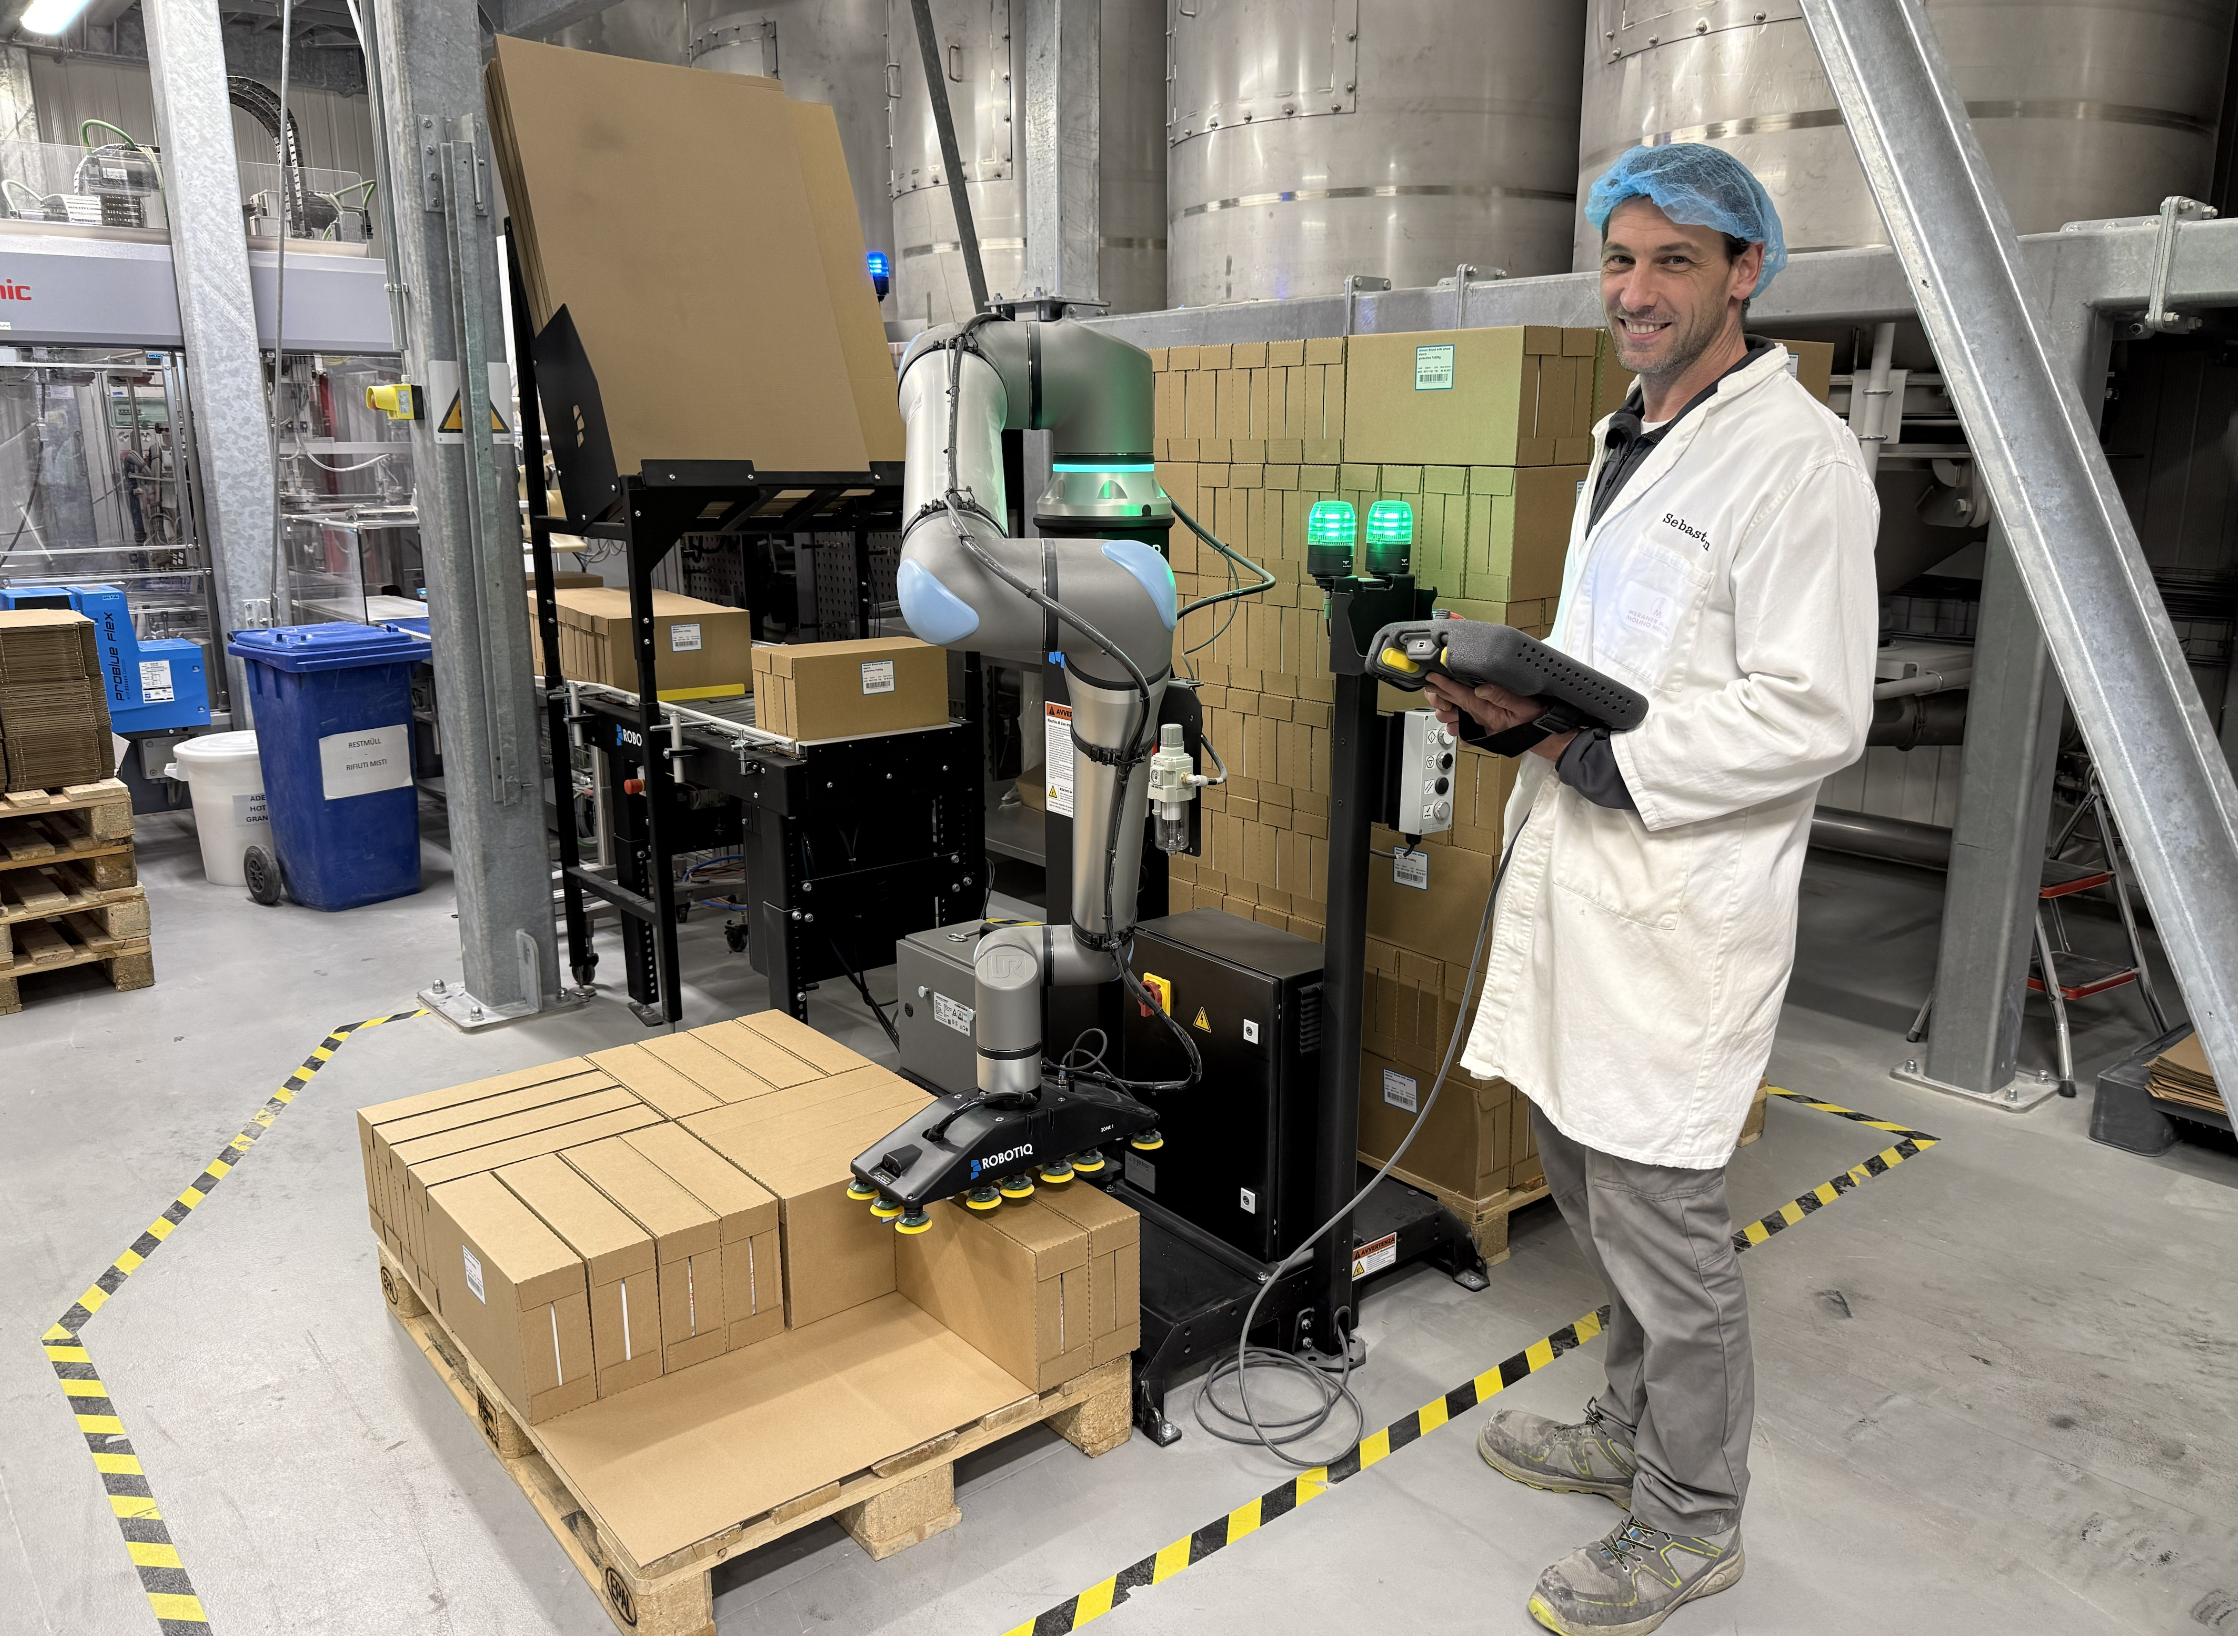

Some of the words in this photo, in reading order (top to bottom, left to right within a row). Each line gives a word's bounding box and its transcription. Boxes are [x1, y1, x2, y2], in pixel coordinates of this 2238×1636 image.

[1626, 615, 1651, 628] MOLINO
[1628, 609, 1658, 625] MERANER
[348, 738, 382, 749] RESTMÜLL
[622, 728, 643, 747] ROBO
[346, 761, 369, 771] RIFIUTI
[369, 758, 387, 768] MISTI
[250, 794, 266, 802] ADE
[250, 804, 266, 812] HOT
[246, 815, 269, 823] GRAN
[982, 1143, 1034, 1170] ROBOTIQ
[610, 1571, 633, 1622] EPAL
